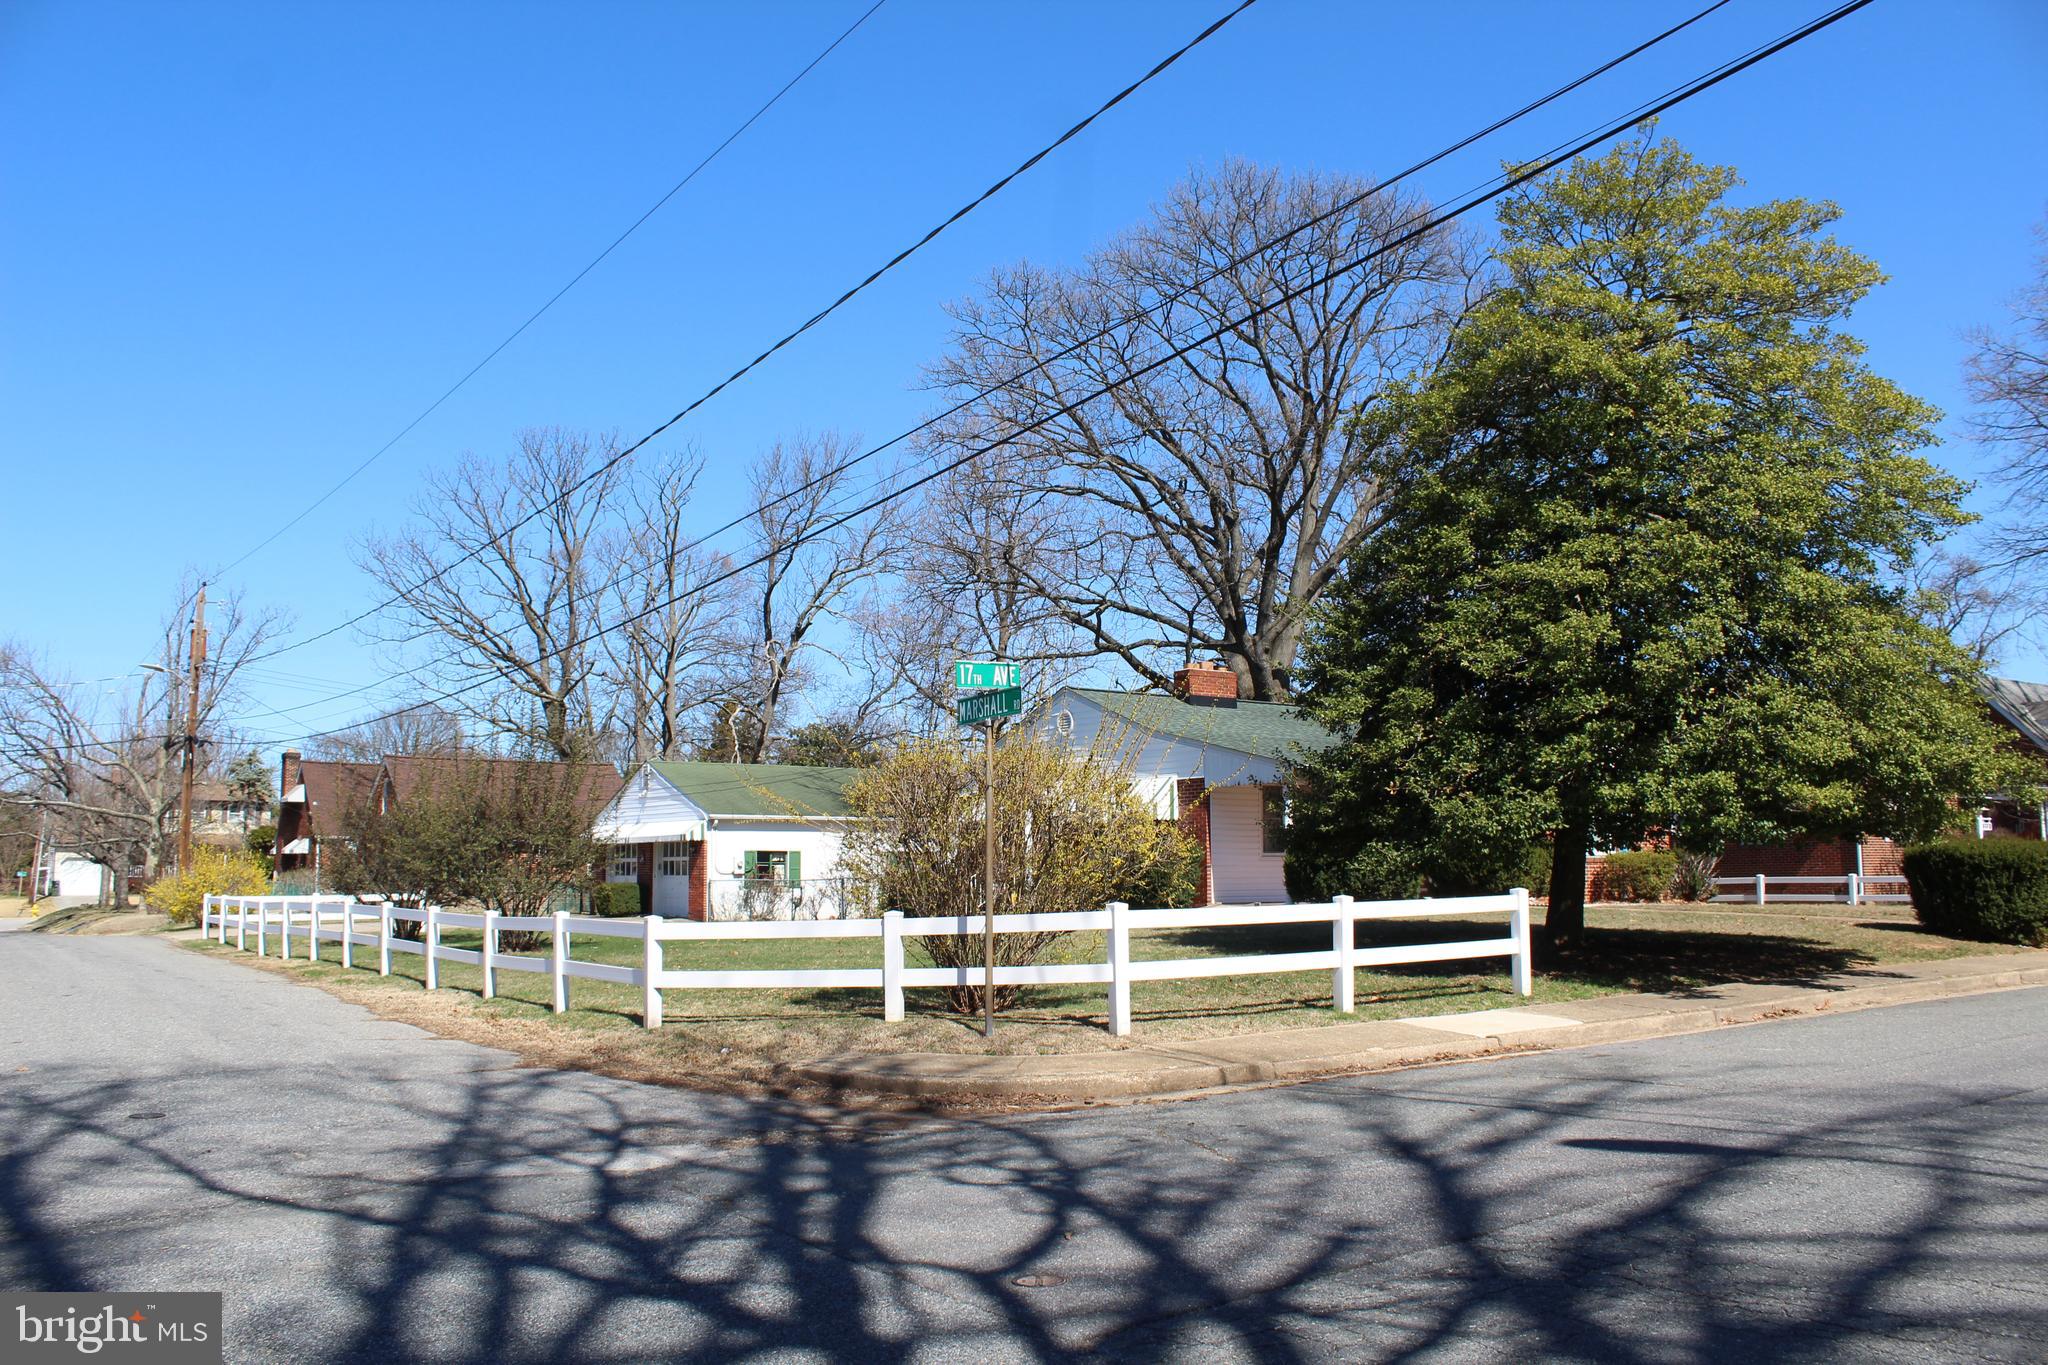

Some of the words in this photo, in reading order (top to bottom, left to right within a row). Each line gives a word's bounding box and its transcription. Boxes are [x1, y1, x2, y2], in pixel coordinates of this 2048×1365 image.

[959, 664, 982, 685] 17TH
[993, 665, 1017, 686] AVE
[959, 693, 1008, 722] MARSHALL
[1013, 699, 1020, 710] RD
